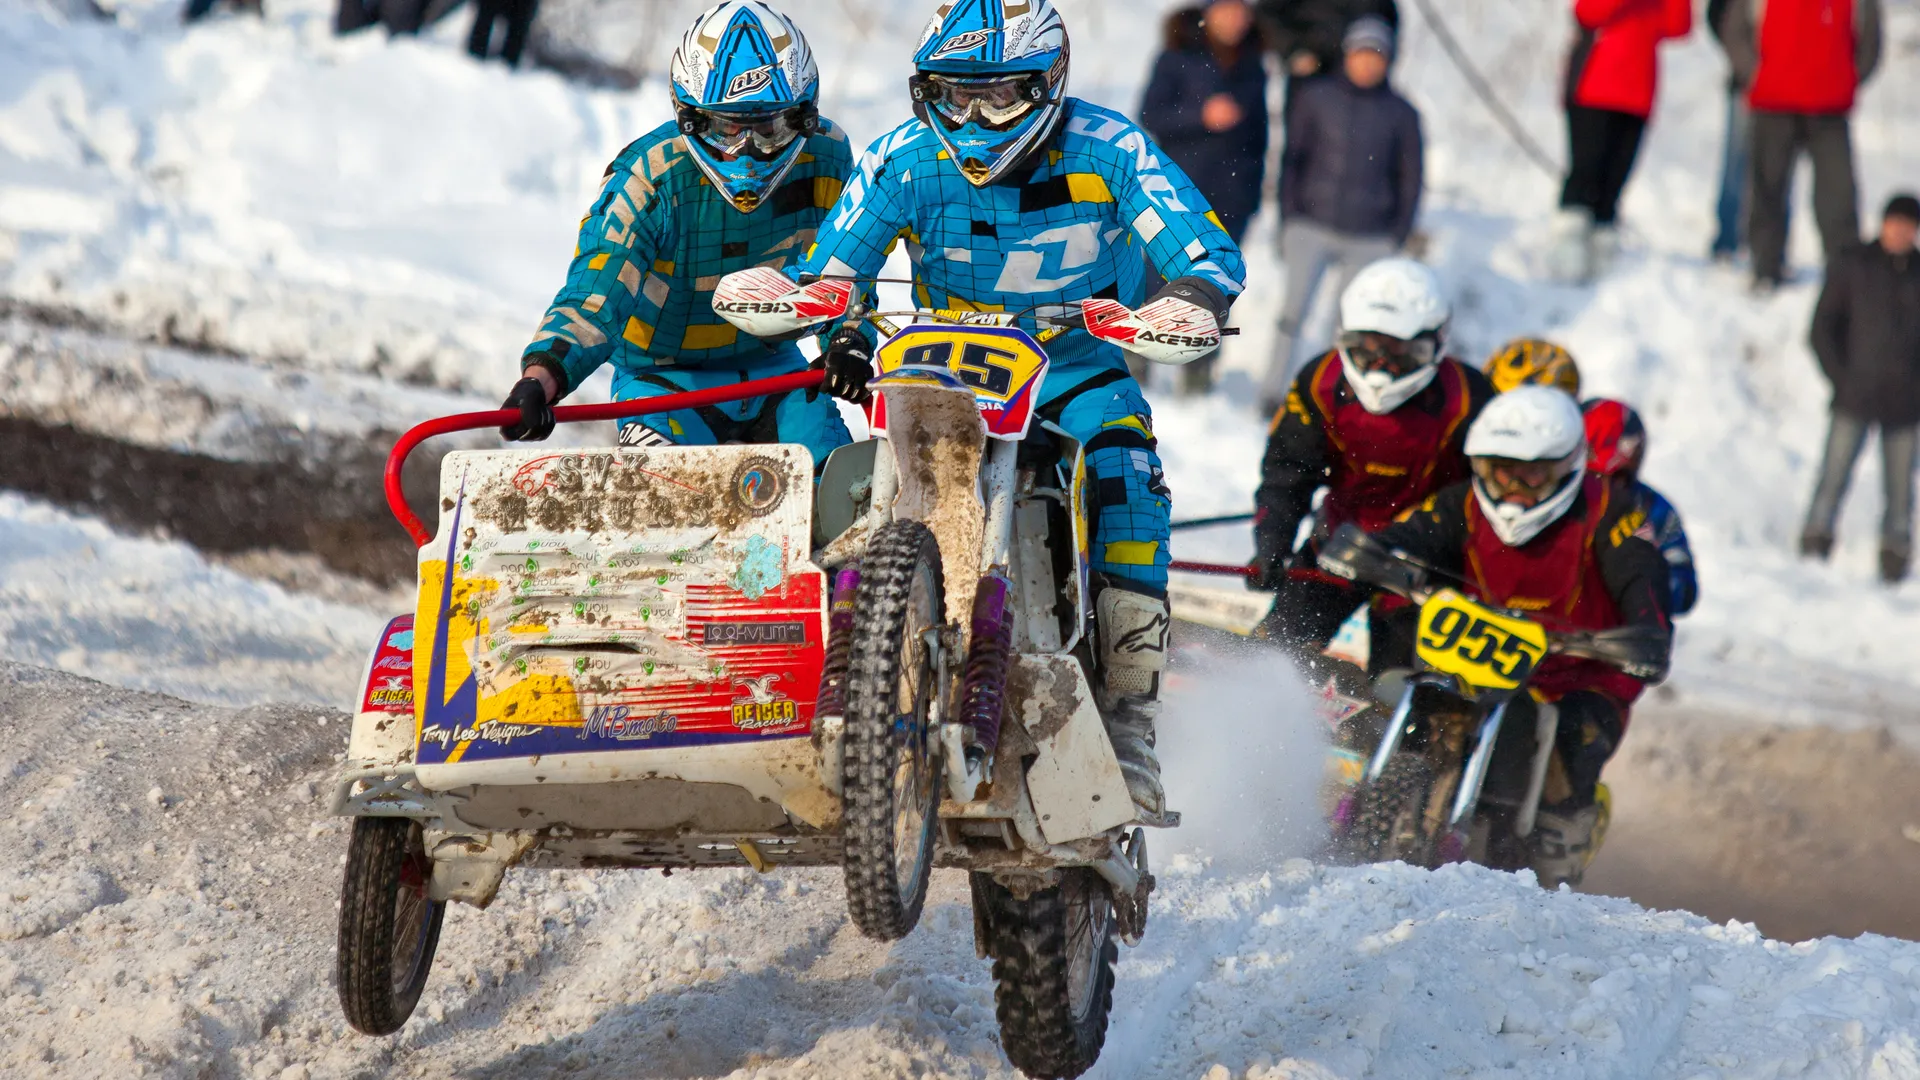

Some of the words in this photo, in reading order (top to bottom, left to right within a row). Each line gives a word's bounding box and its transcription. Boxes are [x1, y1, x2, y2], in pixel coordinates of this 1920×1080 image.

[714, 300, 794, 313] ACERBIS
[1137, 330, 1219, 347] ACERBIS
[978, 401, 1005, 411] SIA
[1421, 606, 1543, 681] 955
[733, 700, 794, 724] REIGER
[453, 724, 479, 742] Lee
[479, 719, 543, 745] Designs
[738, 717, 792, 731] Racing
